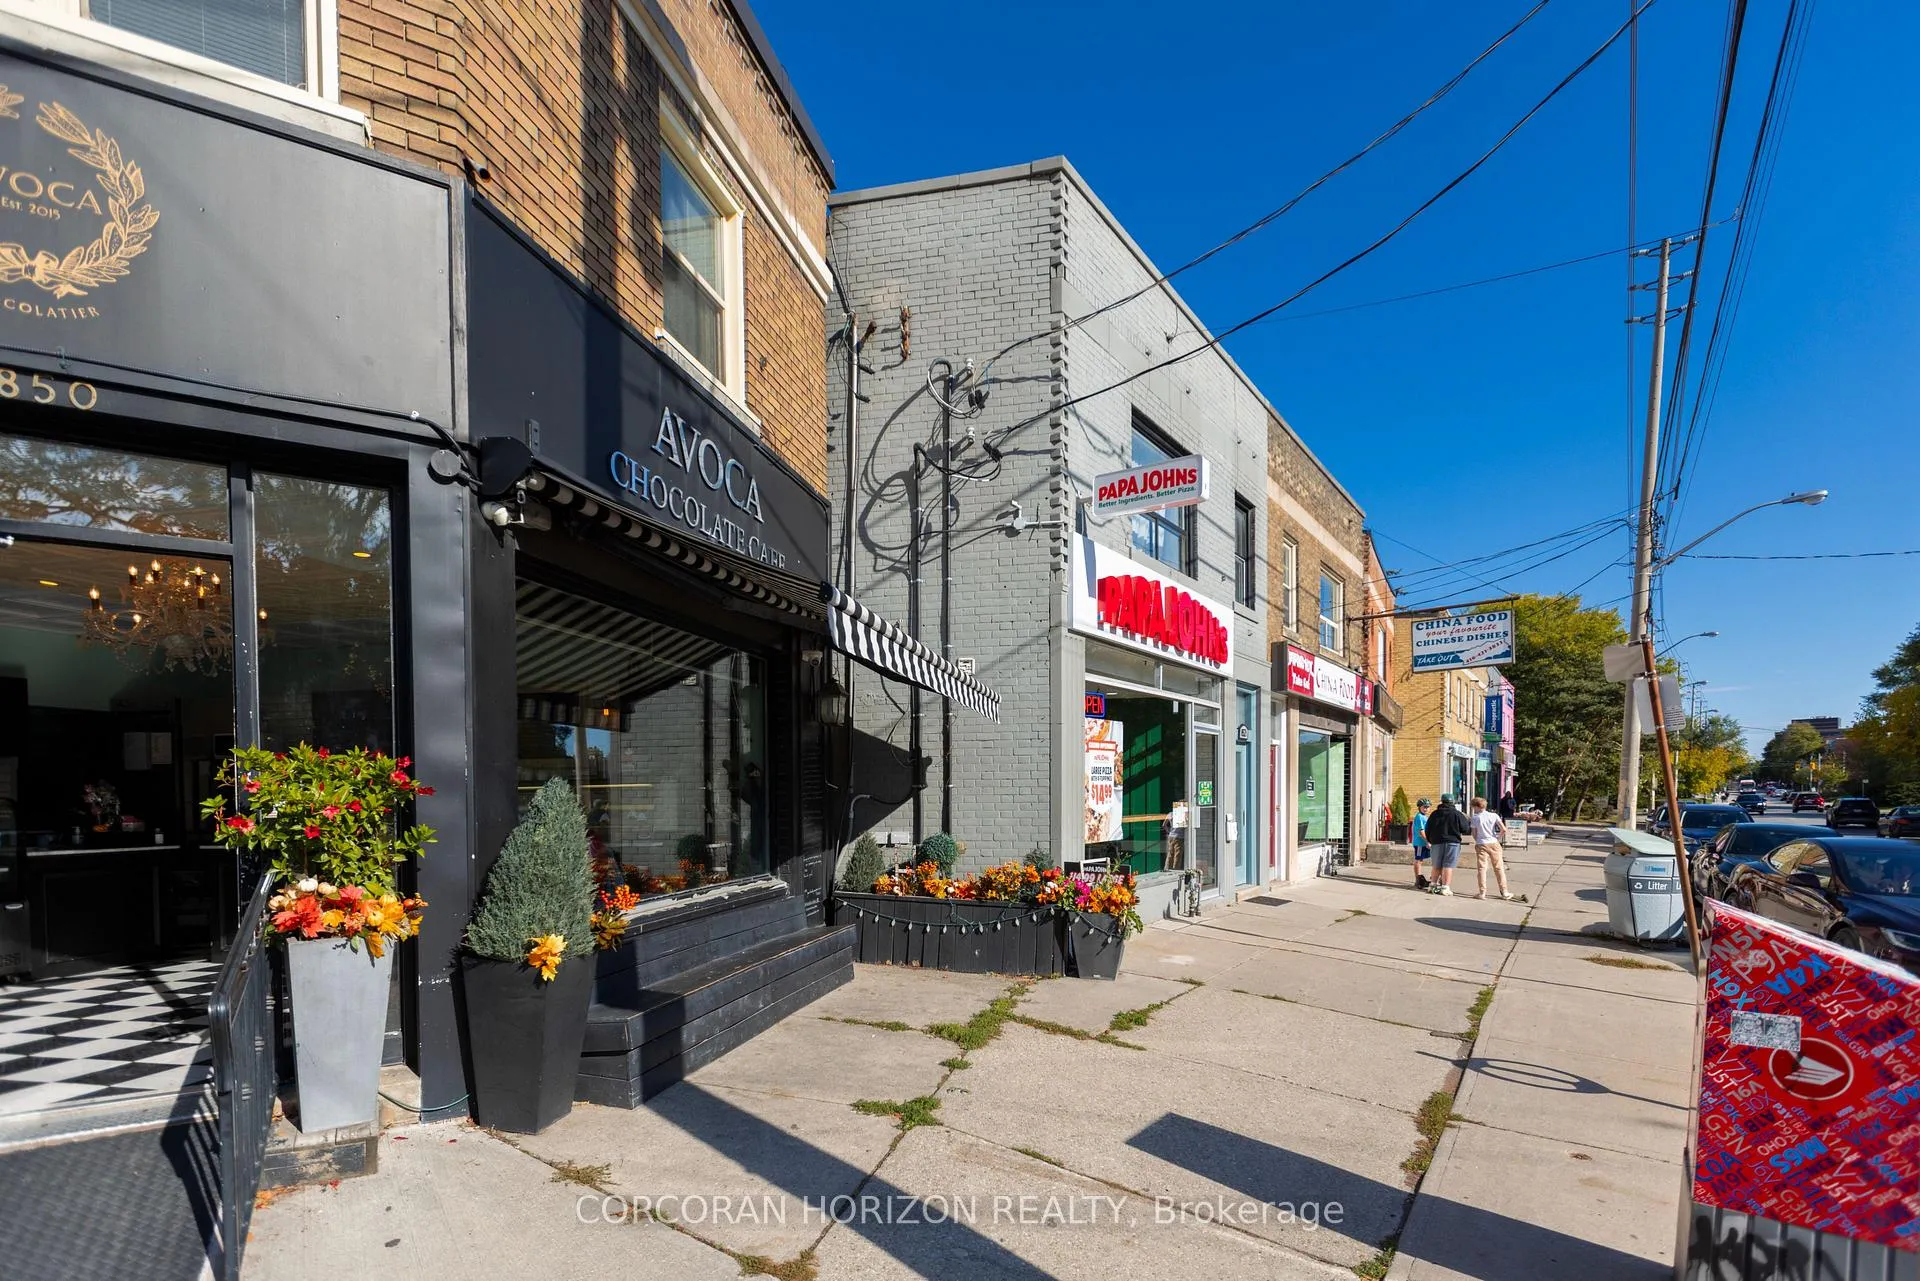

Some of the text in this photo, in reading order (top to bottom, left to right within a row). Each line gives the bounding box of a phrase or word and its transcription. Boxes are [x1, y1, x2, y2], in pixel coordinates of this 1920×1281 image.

[28, 202, 61, 220] 2015
[651, 406, 765, 523] AVOCA
[1097, 467, 1198, 502] PAPA JOHNS
[1098, 498, 1118, 509] Better
[1118, 493, 1155, 506] Ingredients.
[1156, 489, 1176, 498] Better
[609, 450, 747, 555] CHOCOLATE
[1097, 574, 1229, 666] PAPA JOHNS
[1415, 612, 1508, 631] CHINA FOOD
[1425, 623, 1497, 638] your favourite
[1416, 630, 1509, 647] CHINESE DISHES
[1416, 654, 1456, 666] TAKE OUT
[1315, 670, 1338, 695] CHINA
[1339, 678, 1355, 701] FOOD
[1085, 695, 1104, 714] PEN
[1647, 880, 1668, 891] Litter
[1709, 968, 1756, 1010] H9X
[1763, 953, 1832, 997] K4A
[1820, 1000, 1855, 1021] J5T
[1832, 979, 1875, 1016] V7J
[1707, 1069, 1738, 1090] J5T
[1717, 1049, 1755, 1083] V7J
[1883, 1053, 1919, 1083] P9A
[1726, 1080, 1766, 1102] V9L
[1705, 1114, 1754, 1156] G3N
[1769, 1136, 1830, 1175] M6S
[1822, 1181, 1858, 1205] J5T
[1833, 1162, 1876, 1199] V7J
[1780, 1189, 1821, 1224] G3N
